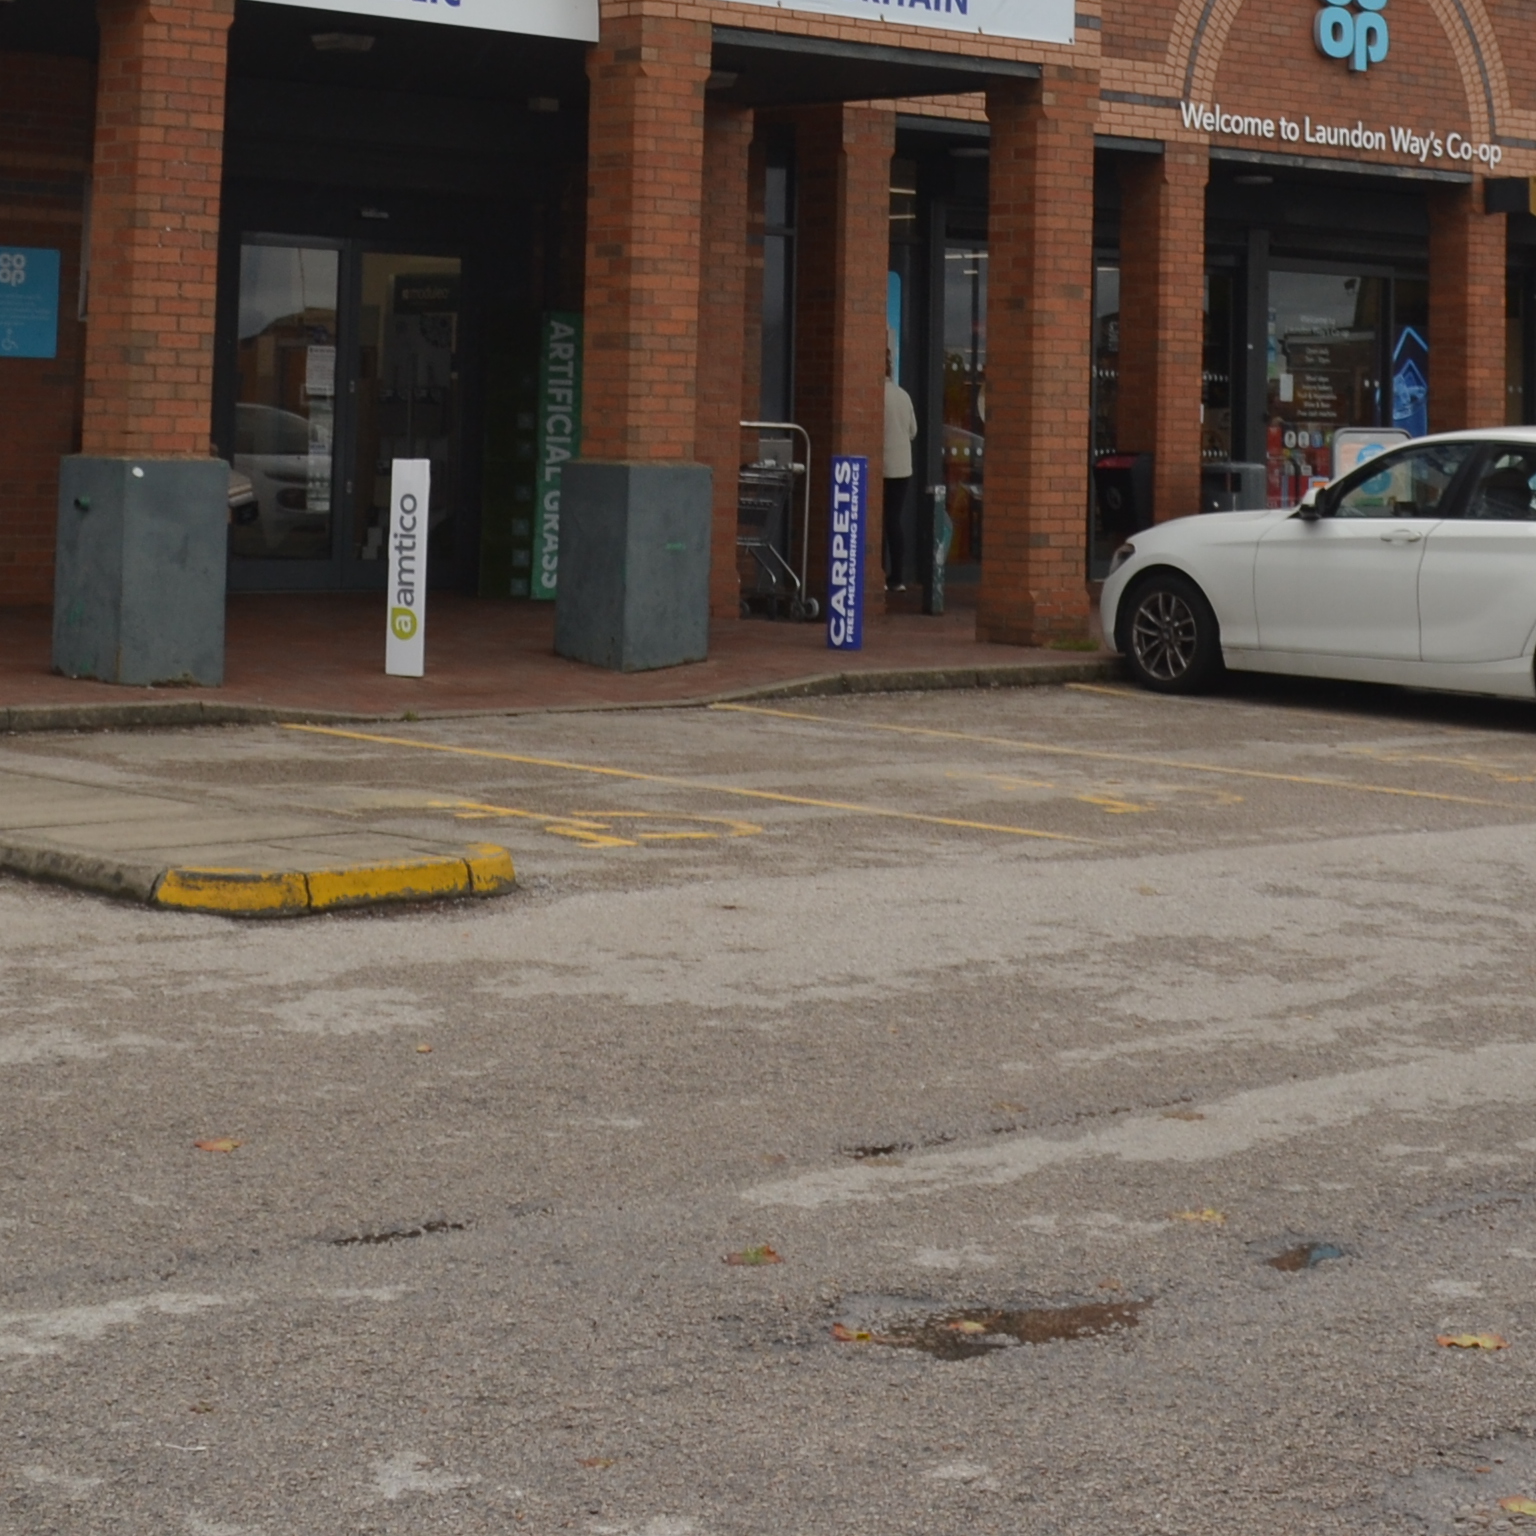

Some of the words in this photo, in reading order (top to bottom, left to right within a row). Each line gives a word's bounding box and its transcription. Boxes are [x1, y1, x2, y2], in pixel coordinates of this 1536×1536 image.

[1180, 101, 1275, 139] Welcome
[1278, 116, 1300, 142] to
[1304, 115, 1386, 151] Laundon
[1390, 126, 1443, 162] Way's
[1446, 133, 1502, 169] Co-op
[544, 320, 575, 482] ARTIFICIAL
[850, 463, 860, 520] SERVICE
[393, 493, 417, 607] amtico
[830, 461, 851, 647] CARPETS
[847, 522, 858, 606] MEASURING
[846, 608, 854, 643] FREE
